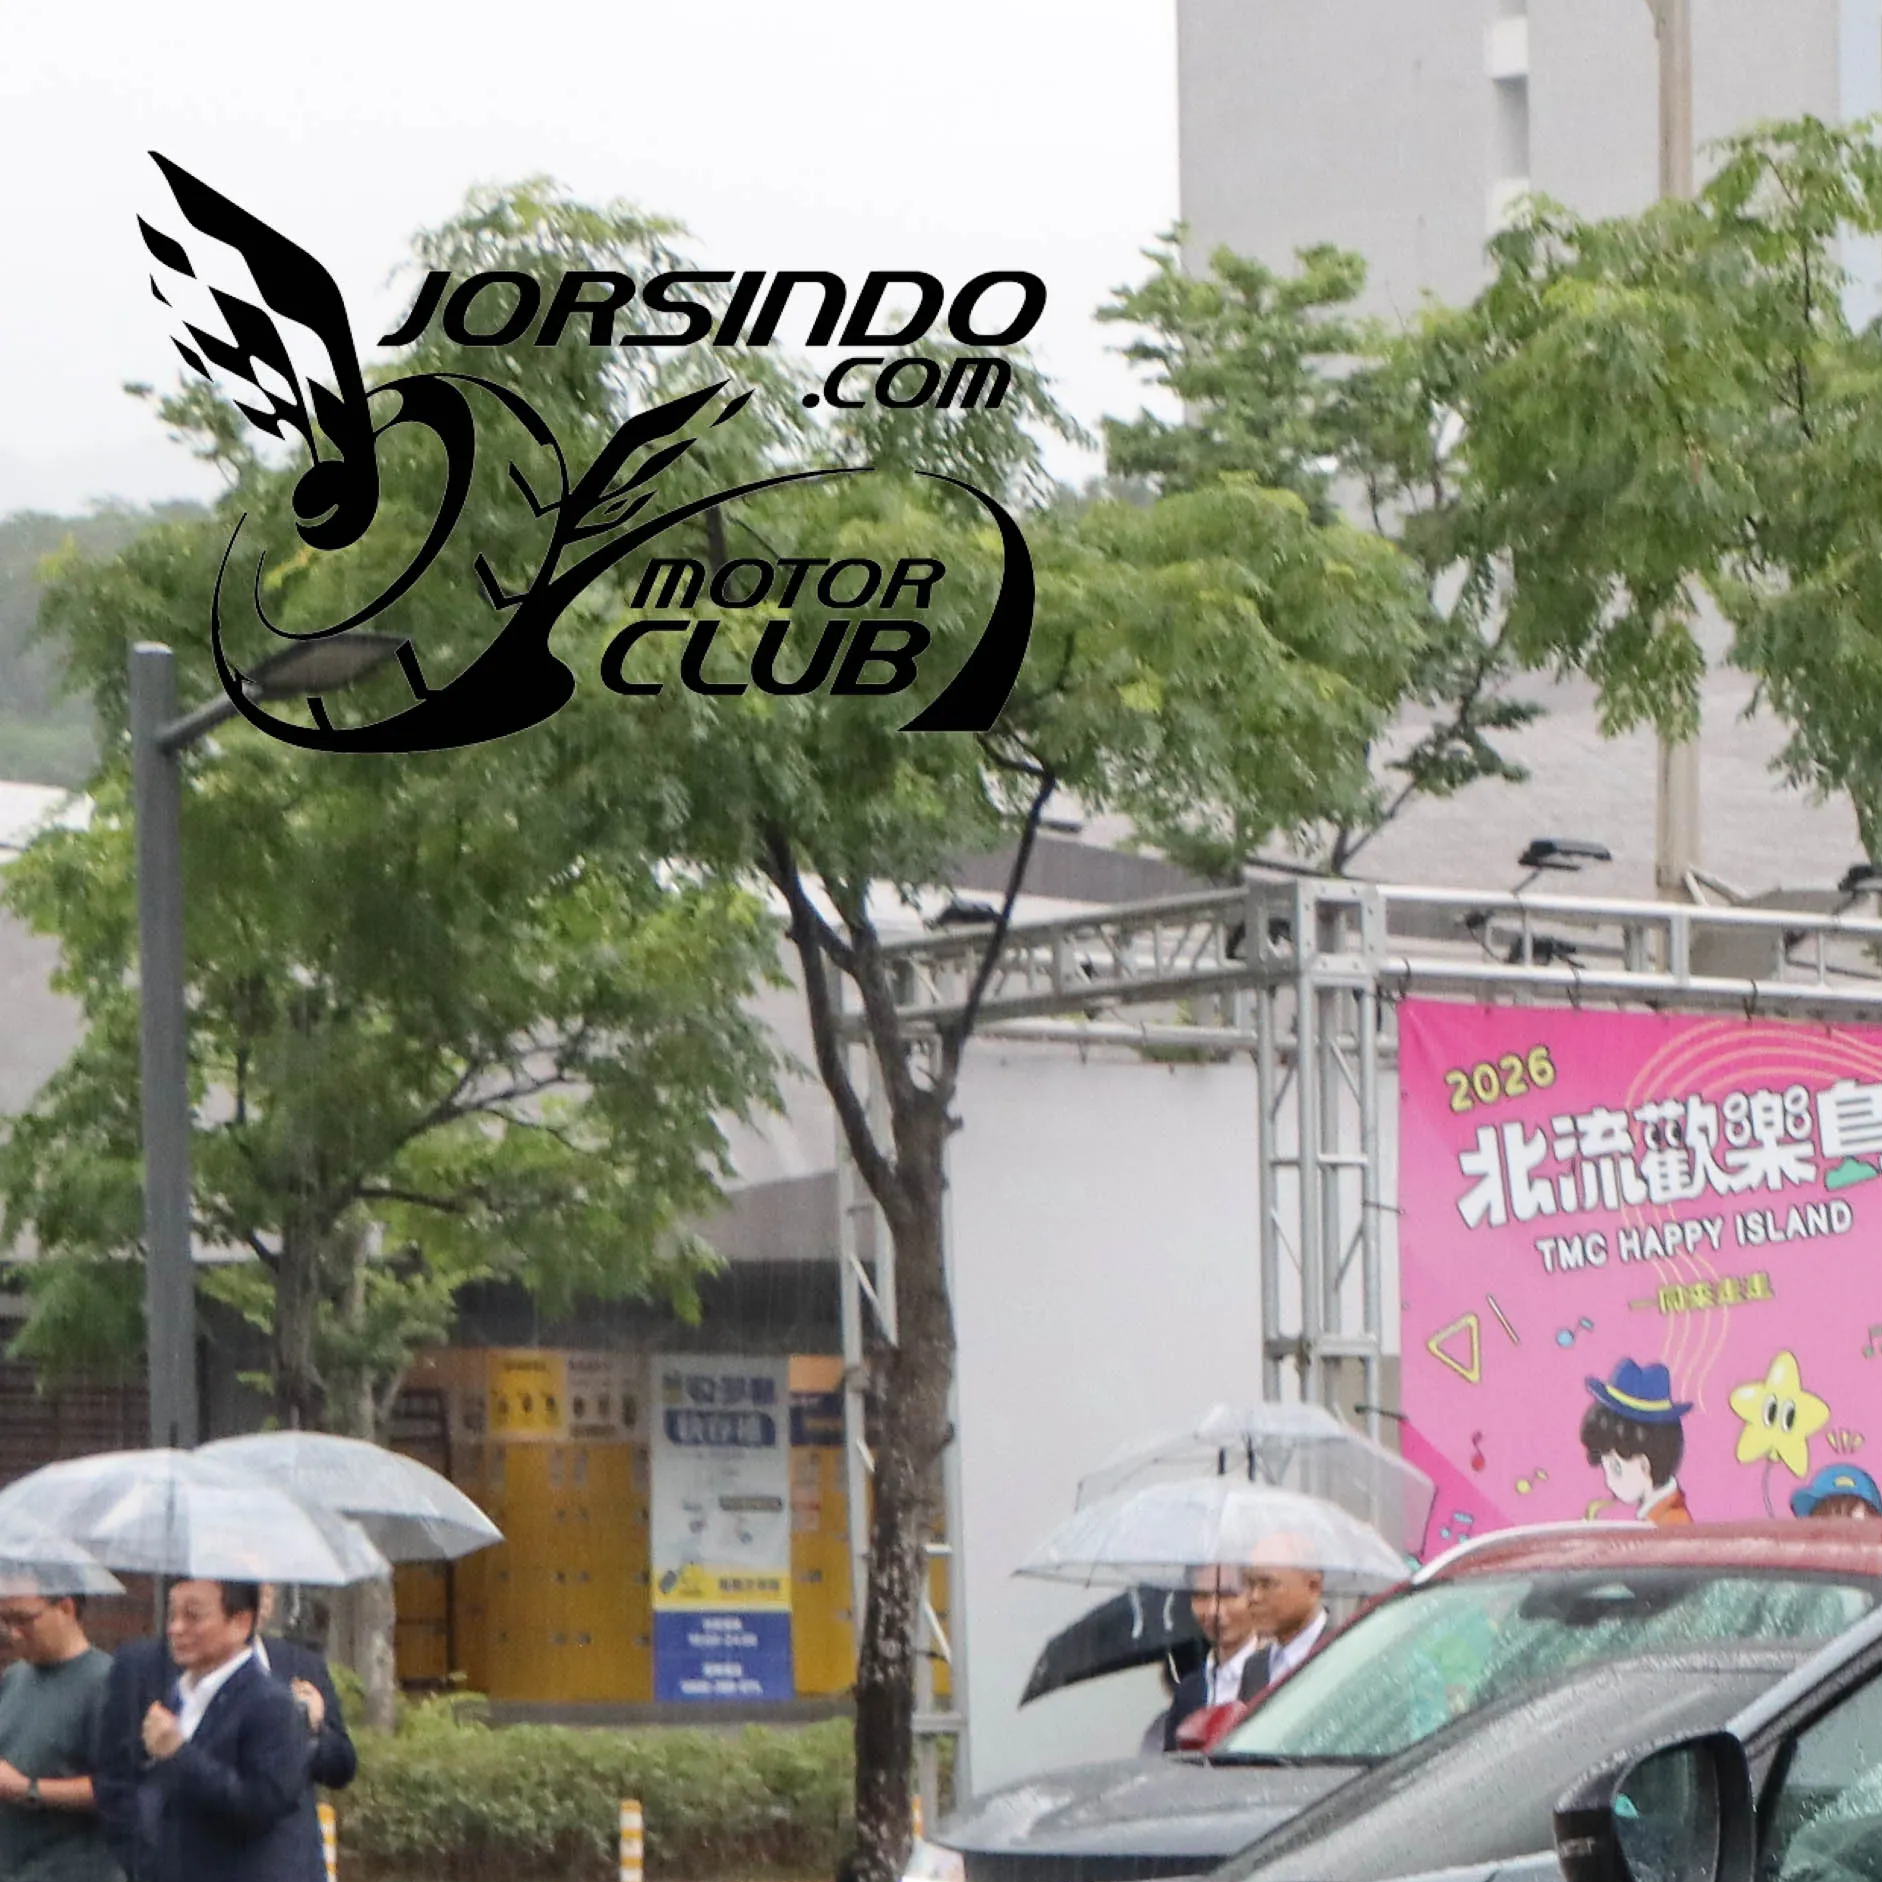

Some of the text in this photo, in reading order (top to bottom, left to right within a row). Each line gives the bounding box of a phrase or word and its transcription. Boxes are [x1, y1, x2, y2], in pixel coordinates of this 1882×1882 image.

[1444, 1044, 1557, 1114] 2026
[1535, 1199, 1854, 1274] TMC HAPPY ISLAND
